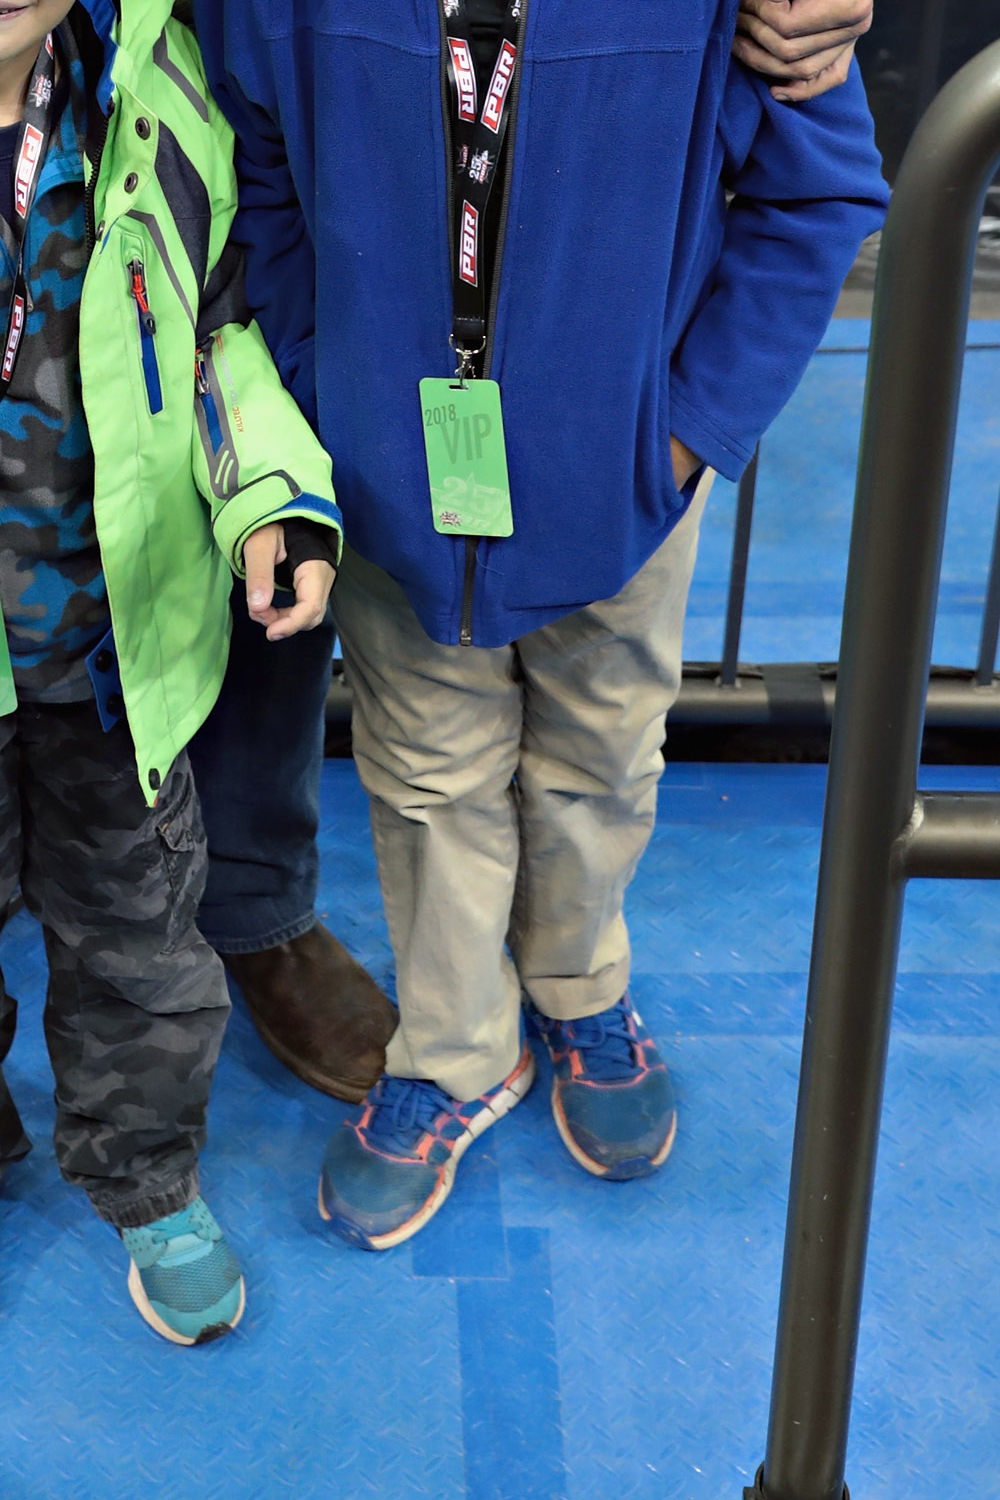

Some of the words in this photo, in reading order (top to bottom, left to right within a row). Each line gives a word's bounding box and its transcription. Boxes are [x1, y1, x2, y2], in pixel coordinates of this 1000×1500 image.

[451, 44, 476, 116] PBR
[484, 49, 516, 123] PBR
[15, 132, 41, 209] PBR
[461, 209, 477, 279] PBR
[4, 303, 22, 374] PBR
[424, 403, 457, 427] 2018
[440, 412, 492, 465] VIP
